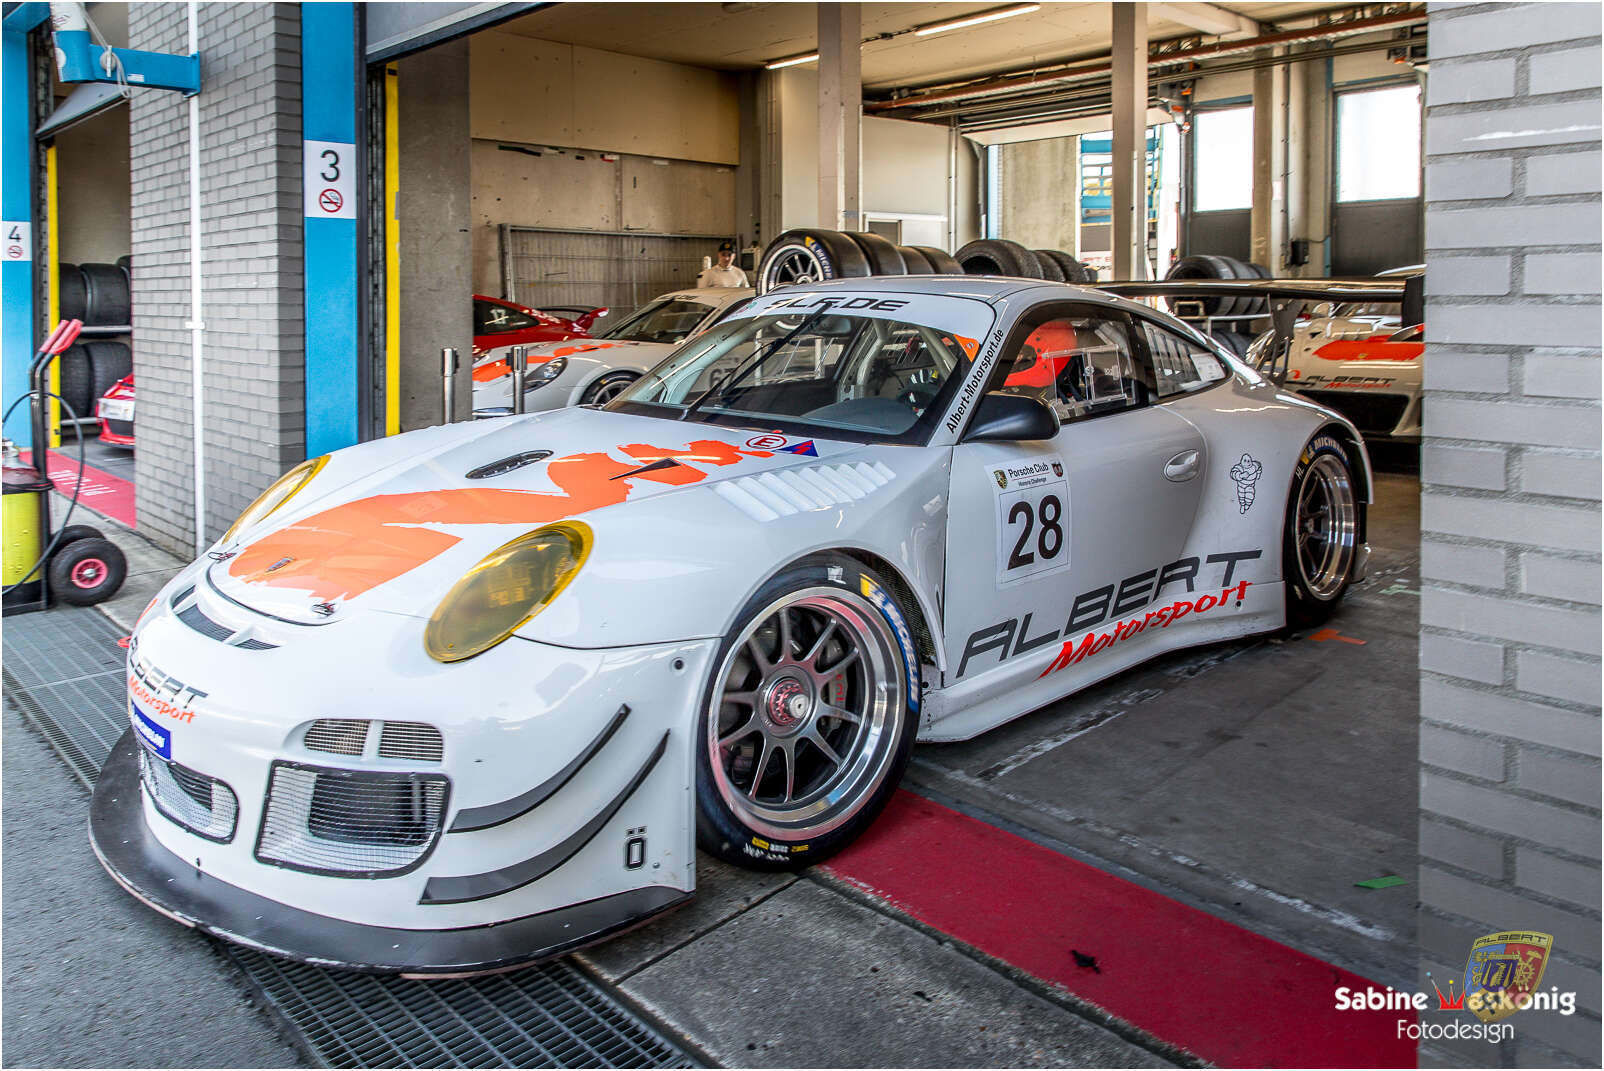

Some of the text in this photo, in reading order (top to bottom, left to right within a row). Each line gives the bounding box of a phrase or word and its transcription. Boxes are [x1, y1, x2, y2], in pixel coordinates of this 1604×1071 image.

[320, 149, 340, 182] 3
[8, 225, 22, 242] 4
[946, 329, 1004, 434] Albert-Motorsport.de
[1008, 462, 1049, 478] Porsche Club
[1007, 494, 1064, 571] 28
[956, 549, 1262, 679] ALBERT
[1033, 580, 1253, 682] Motorsport
[626, 826, 647, 869] Ö
